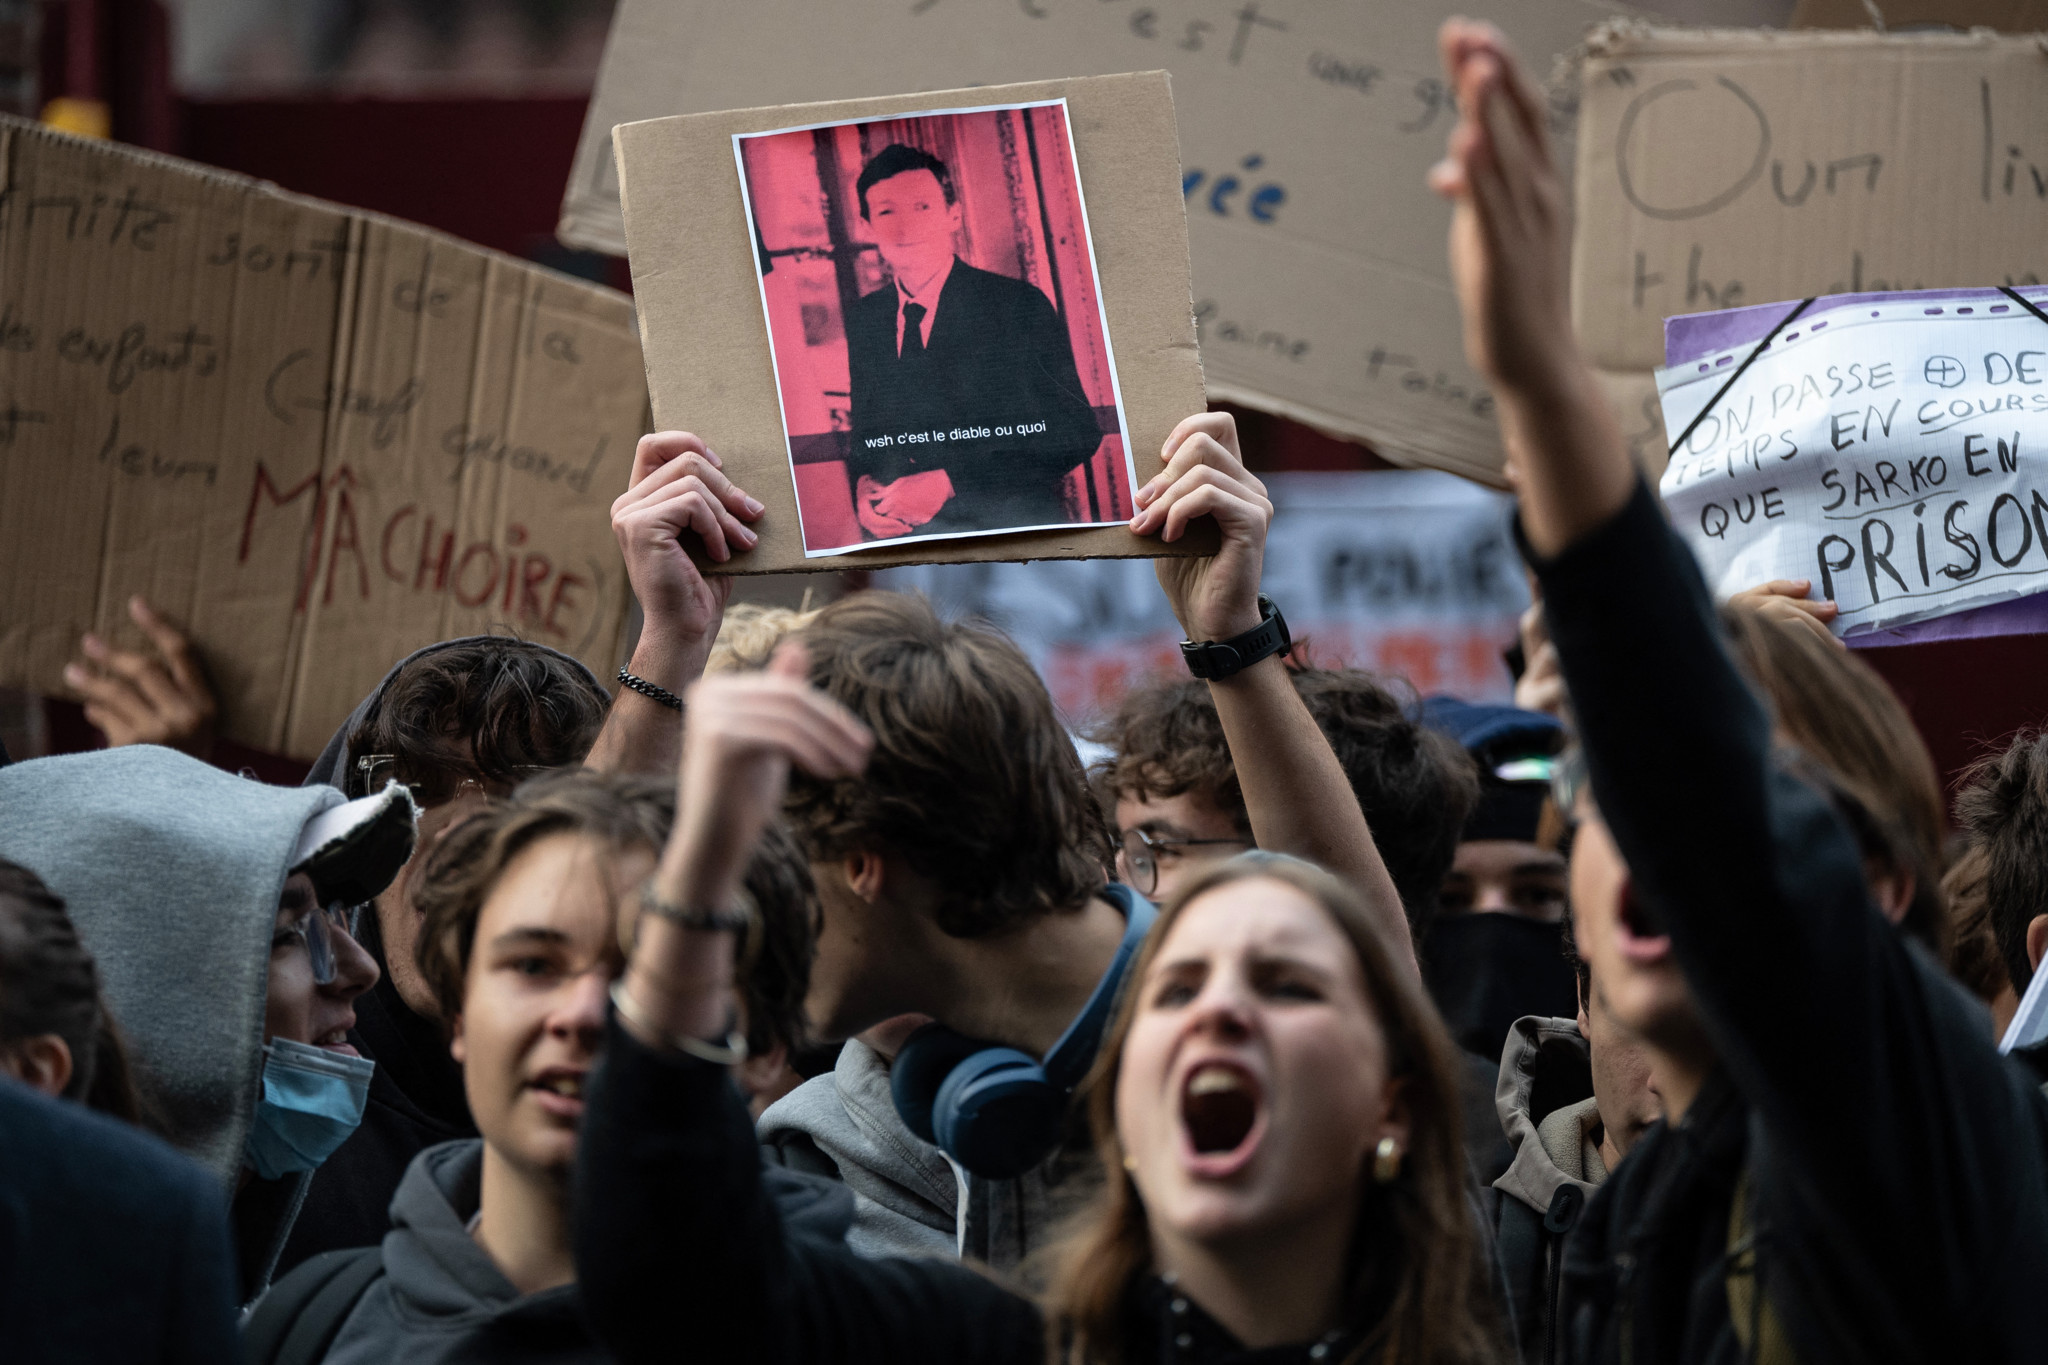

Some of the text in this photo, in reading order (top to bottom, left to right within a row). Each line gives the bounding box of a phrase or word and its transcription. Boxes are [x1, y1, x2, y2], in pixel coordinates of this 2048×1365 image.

[865, 419, 1047, 449] wsh c'est le diable ou quoi
[1676, 428, 1799, 486] TEMPS
[1831, 399, 1902, 452] EN
[1686, 395, 1755, 455] ON
[1773, 362, 1897, 419] PASSE
[1984, 351, 2047, 386] DE
[1701, 430, 2020, 541] QUE SARKO EN
